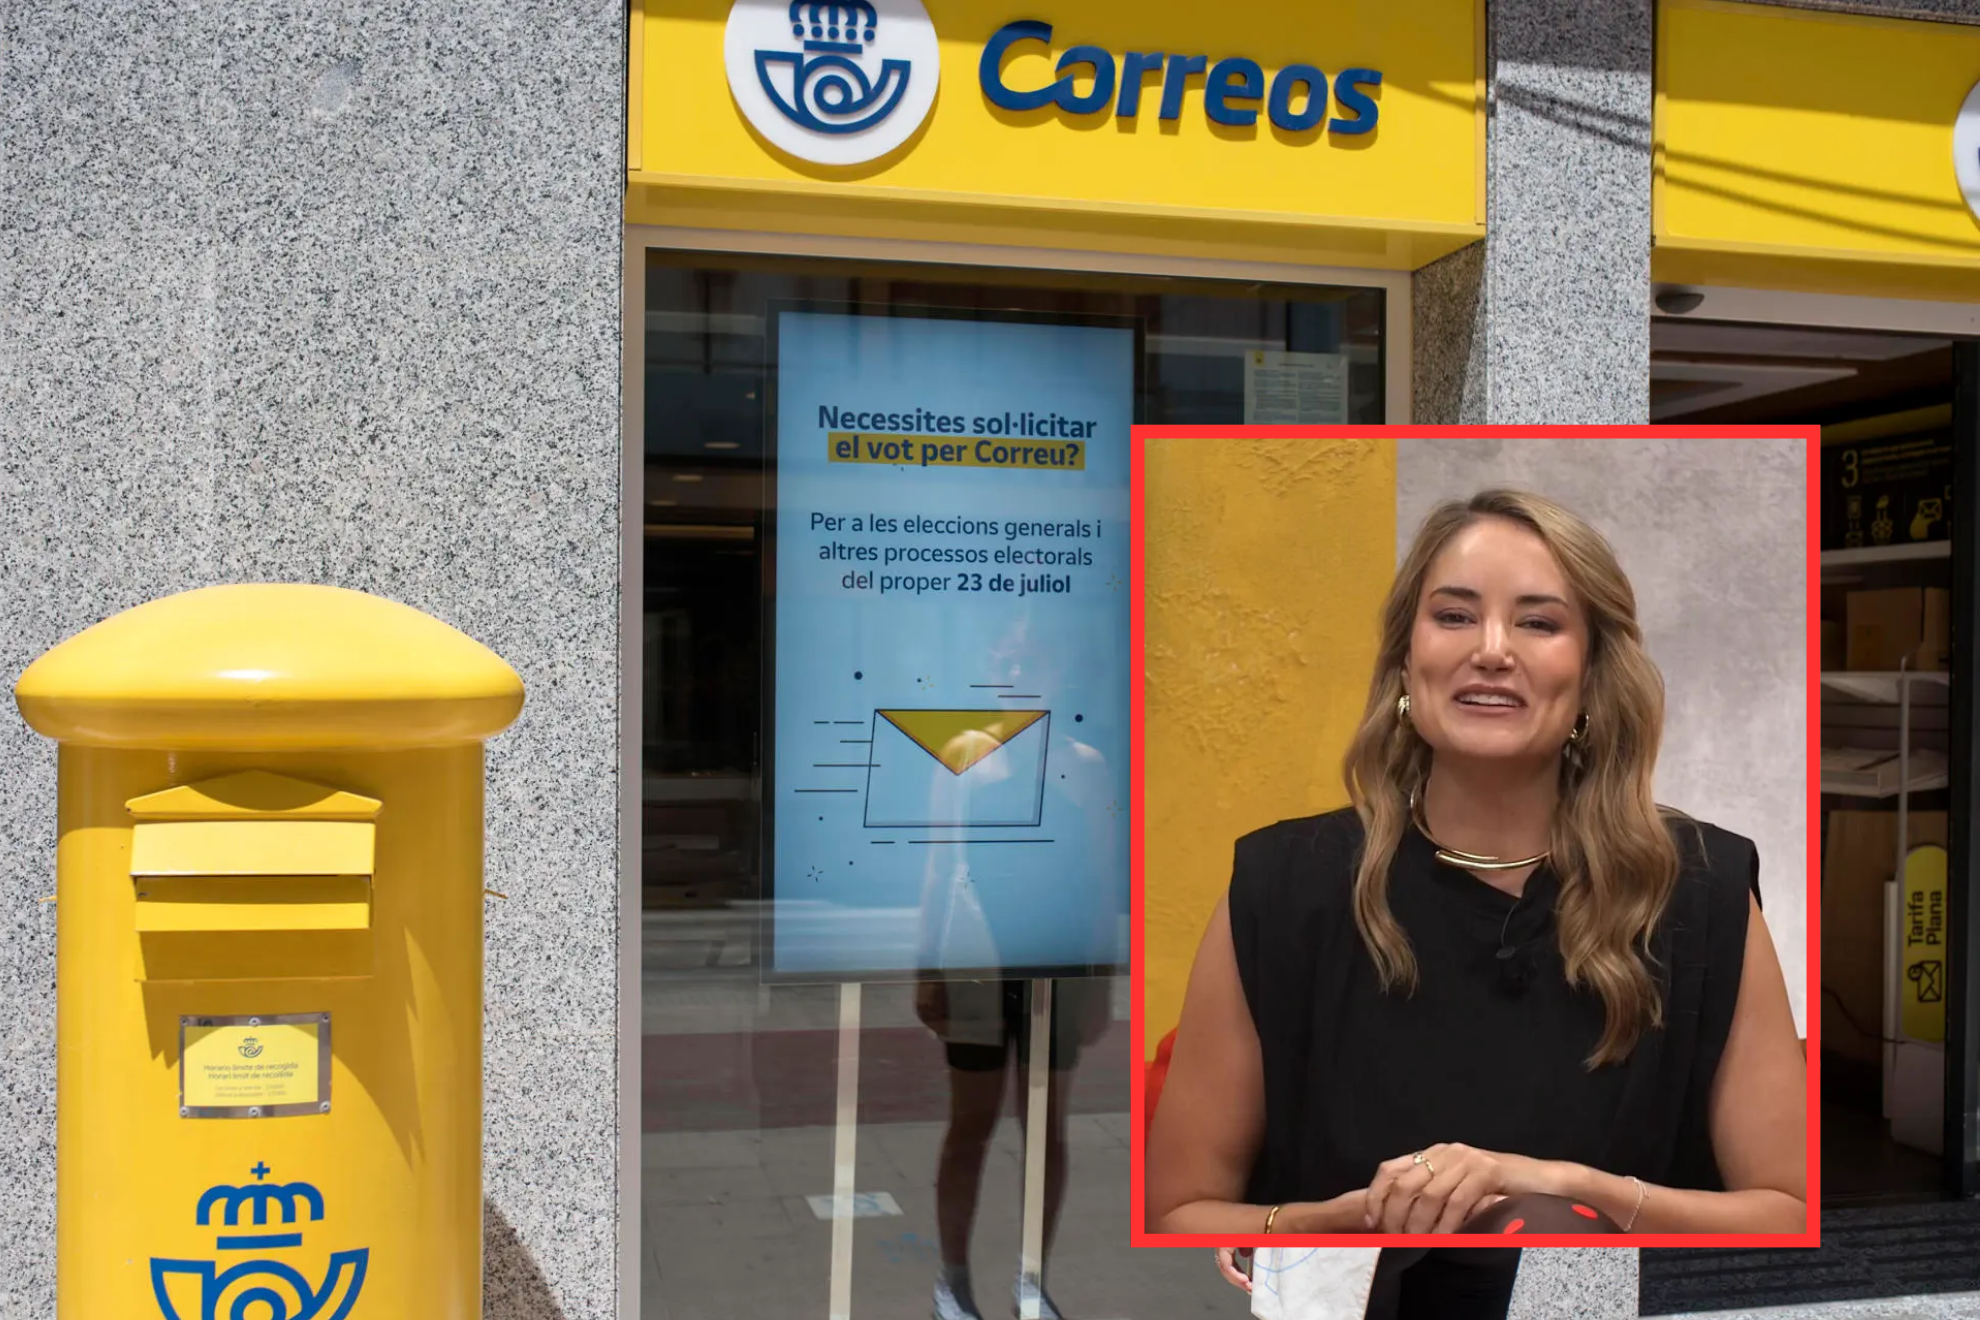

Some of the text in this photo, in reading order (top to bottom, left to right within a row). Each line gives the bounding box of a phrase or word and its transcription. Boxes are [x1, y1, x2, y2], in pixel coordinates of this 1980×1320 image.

[978, 18, 1383, 137] Correos
[817, 405, 1097, 438] Necessites sol·licitar
[835, 435, 1080, 466] el vot per Correu?
[1840, 449, 1859, 489] 3
[810, 512, 1101, 541] Per a les eleccions generals i
[819, 541, 1093, 566] altres processos electorals
[841, 571, 1071, 597] del proper 23 de juliol
[1908, 891, 1924, 947] Tarifa
[1926, 891, 1942, 945] Plana
